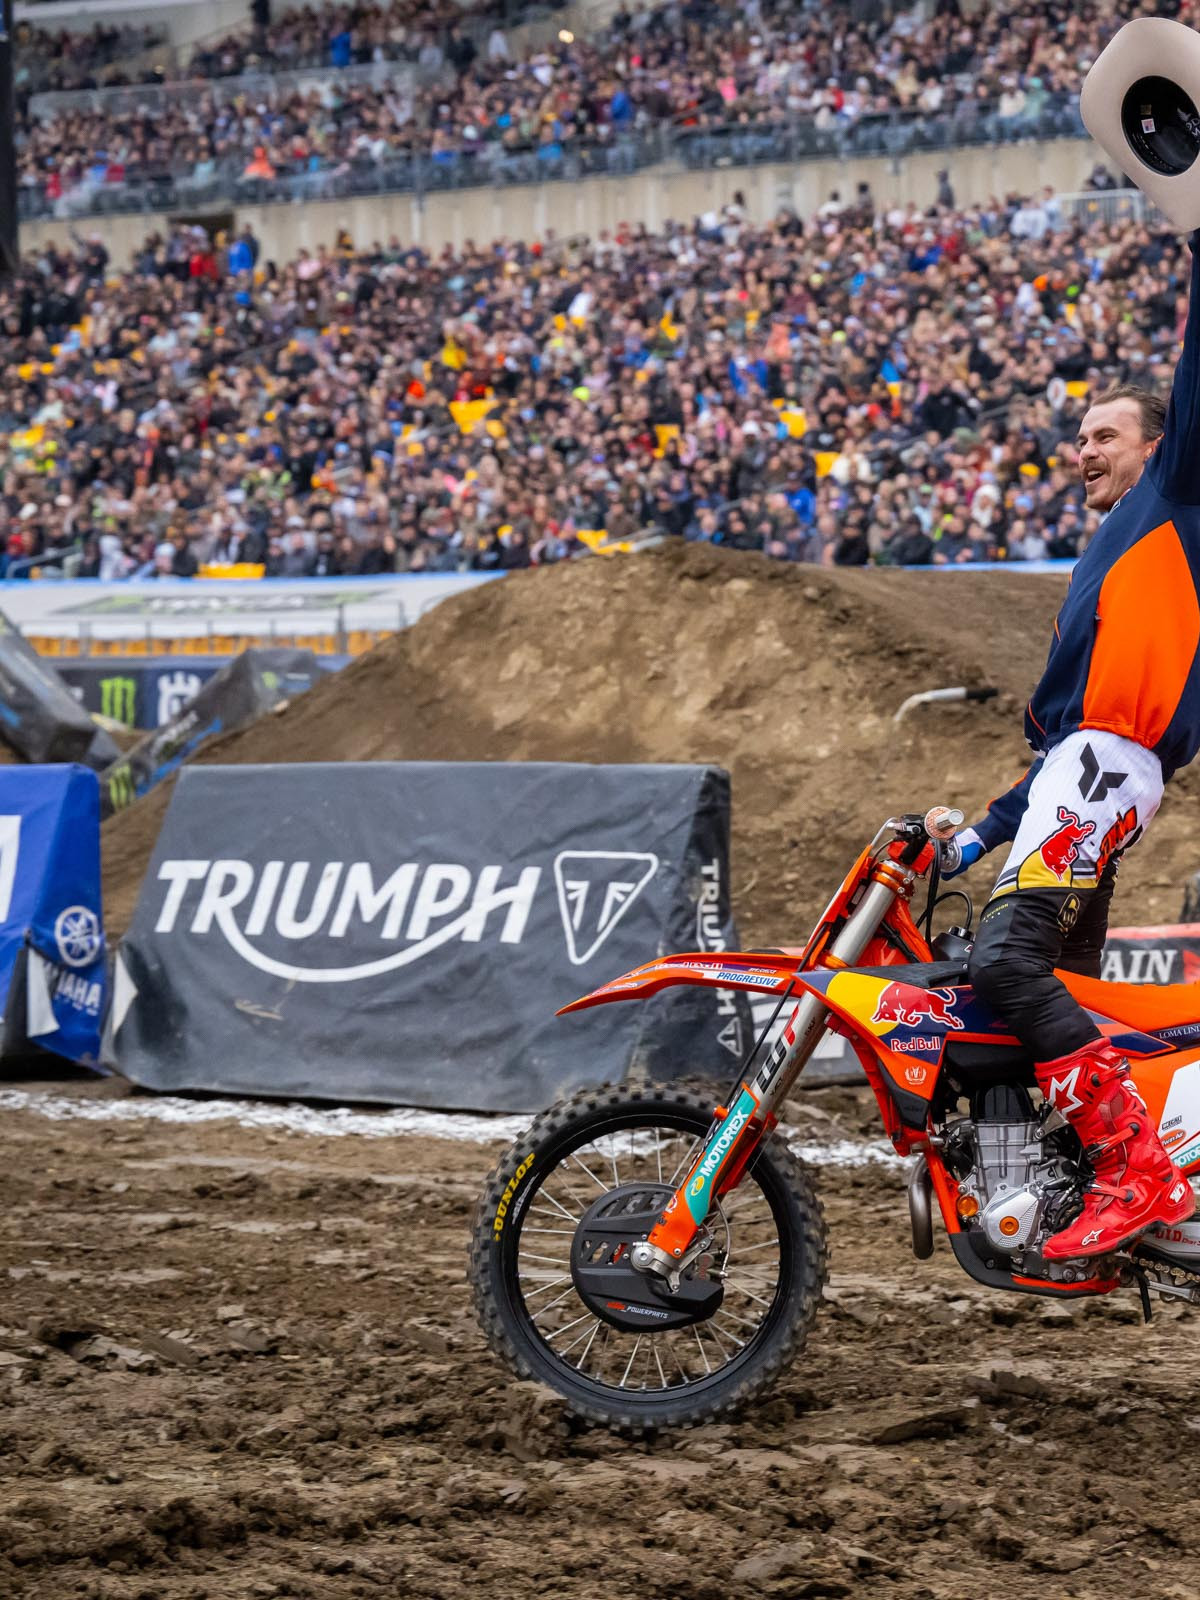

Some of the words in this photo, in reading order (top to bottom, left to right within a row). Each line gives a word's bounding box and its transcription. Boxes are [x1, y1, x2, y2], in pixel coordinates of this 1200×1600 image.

[155, 860, 542, 982] TRIUMPH
[697, 858, 737, 1015] TRIUH
[717, 972, 780, 987] PROGRESSIVE
[1100, 949, 1178, 983] AIN
[1159, 1029, 1182, 1039] LOMA
[701, 1110, 750, 1177] MOTOREX
[494, 1152, 536, 1231] DUNLOP
[627, 1305, 669, 1319] POWERPARTS
